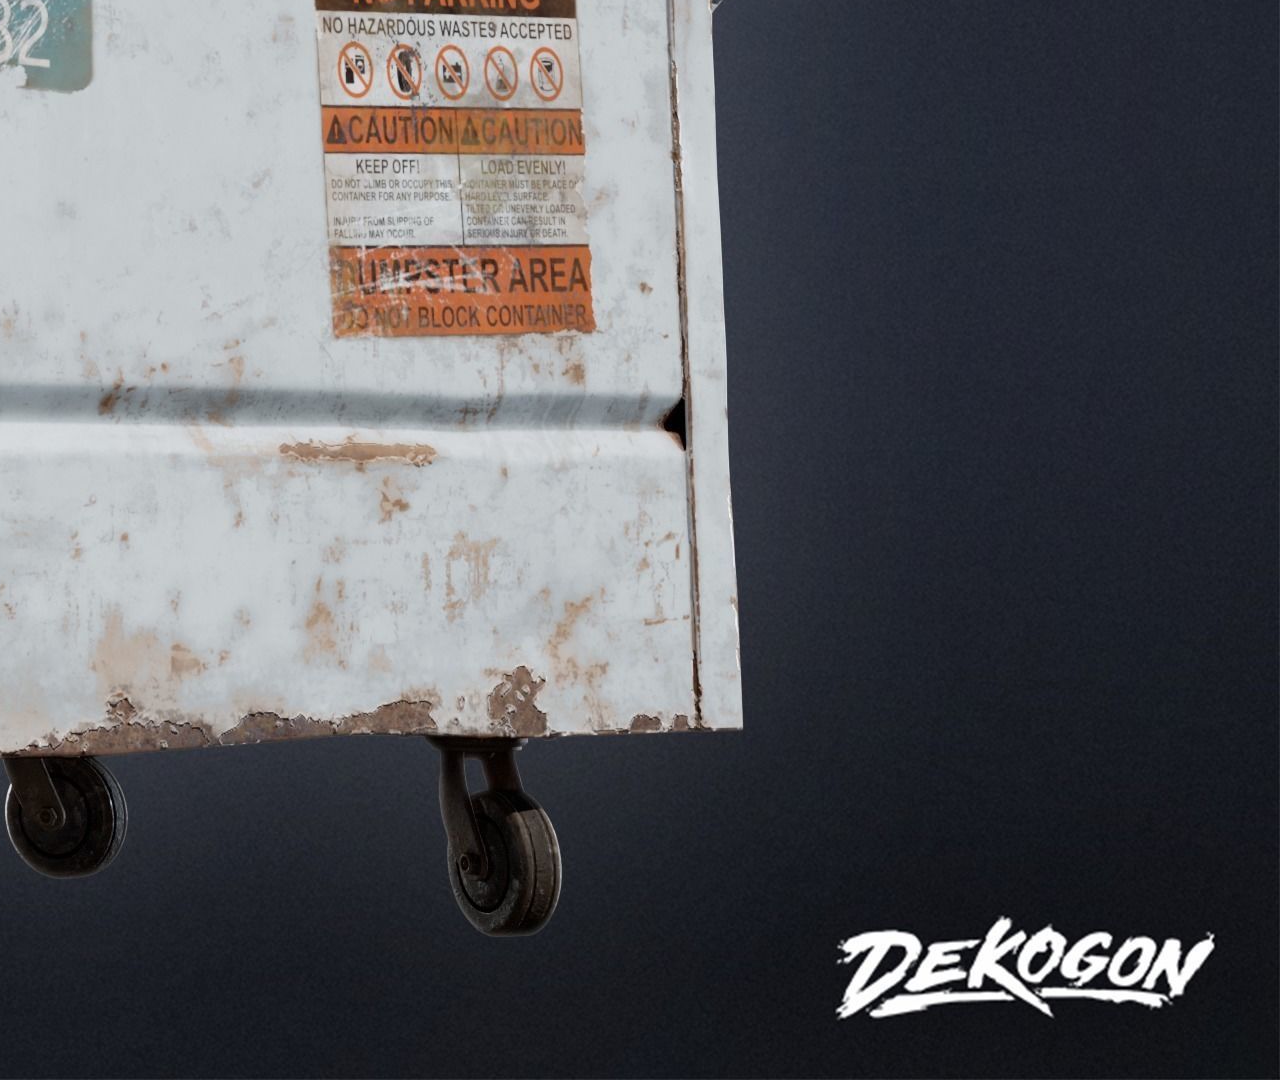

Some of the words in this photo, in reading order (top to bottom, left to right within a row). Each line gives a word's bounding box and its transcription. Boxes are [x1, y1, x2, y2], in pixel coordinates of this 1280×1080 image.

[322, 17, 343, 34] NO
[349, 18, 435, 37] HAZARDOUS
[439, 20, 497, 38] WASTES
[500, 22, 572, 40] ACCEPTED
[348, 115, 454, 144] CAUTION
[482, 119, 583, 146] CAUTION
[356, 159, 388, 174] KEEP
[392, 159, 420, 174] OFF!
[480, 160, 514, 174] LOAD
[517, 160, 566, 175] EVENLY!
[331, 179, 342, 189] DO
[344, 179, 360, 189] NOT
[388, 179, 400, 189] OR
[402, 179, 433, 189] OCCUPY
[331, 191, 376, 201] CONTAINER
[378, 192, 395, 201] FOR
[396, 192, 412, 201] ANY
[506, 204, 544, 214] UNEVENLY
[545, 204, 576, 214] LOADED
[368, 229, 384, 239] MAY
[508, 258, 589, 293] AREA
[418, 306, 481, 329] BLOCK
[486, 304, 588, 327] CONTAINER
